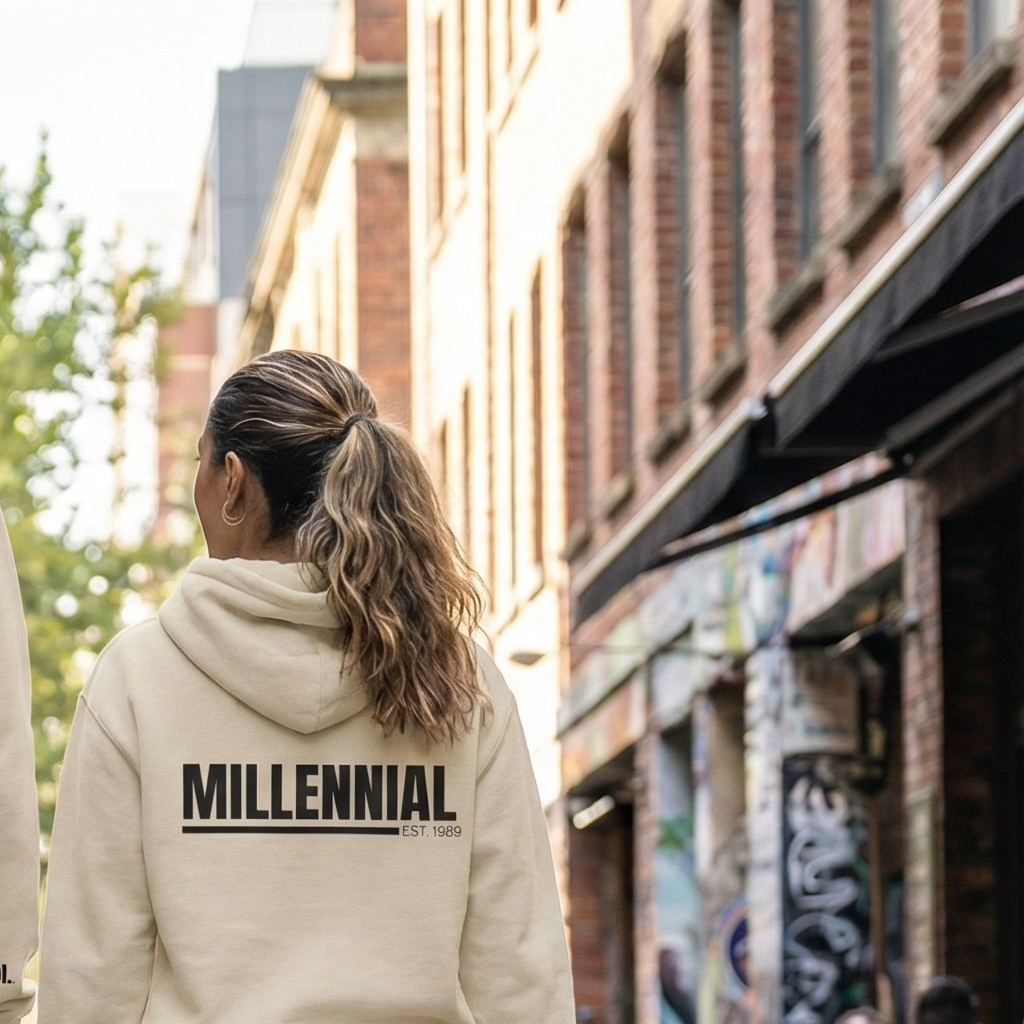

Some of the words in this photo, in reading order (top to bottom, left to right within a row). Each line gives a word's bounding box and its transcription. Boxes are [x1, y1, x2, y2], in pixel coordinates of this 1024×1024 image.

[182, 763, 457, 822] MILLENNIAL
[402, 825, 430, 838] EST.
[432, 825, 462, 838] 1989
